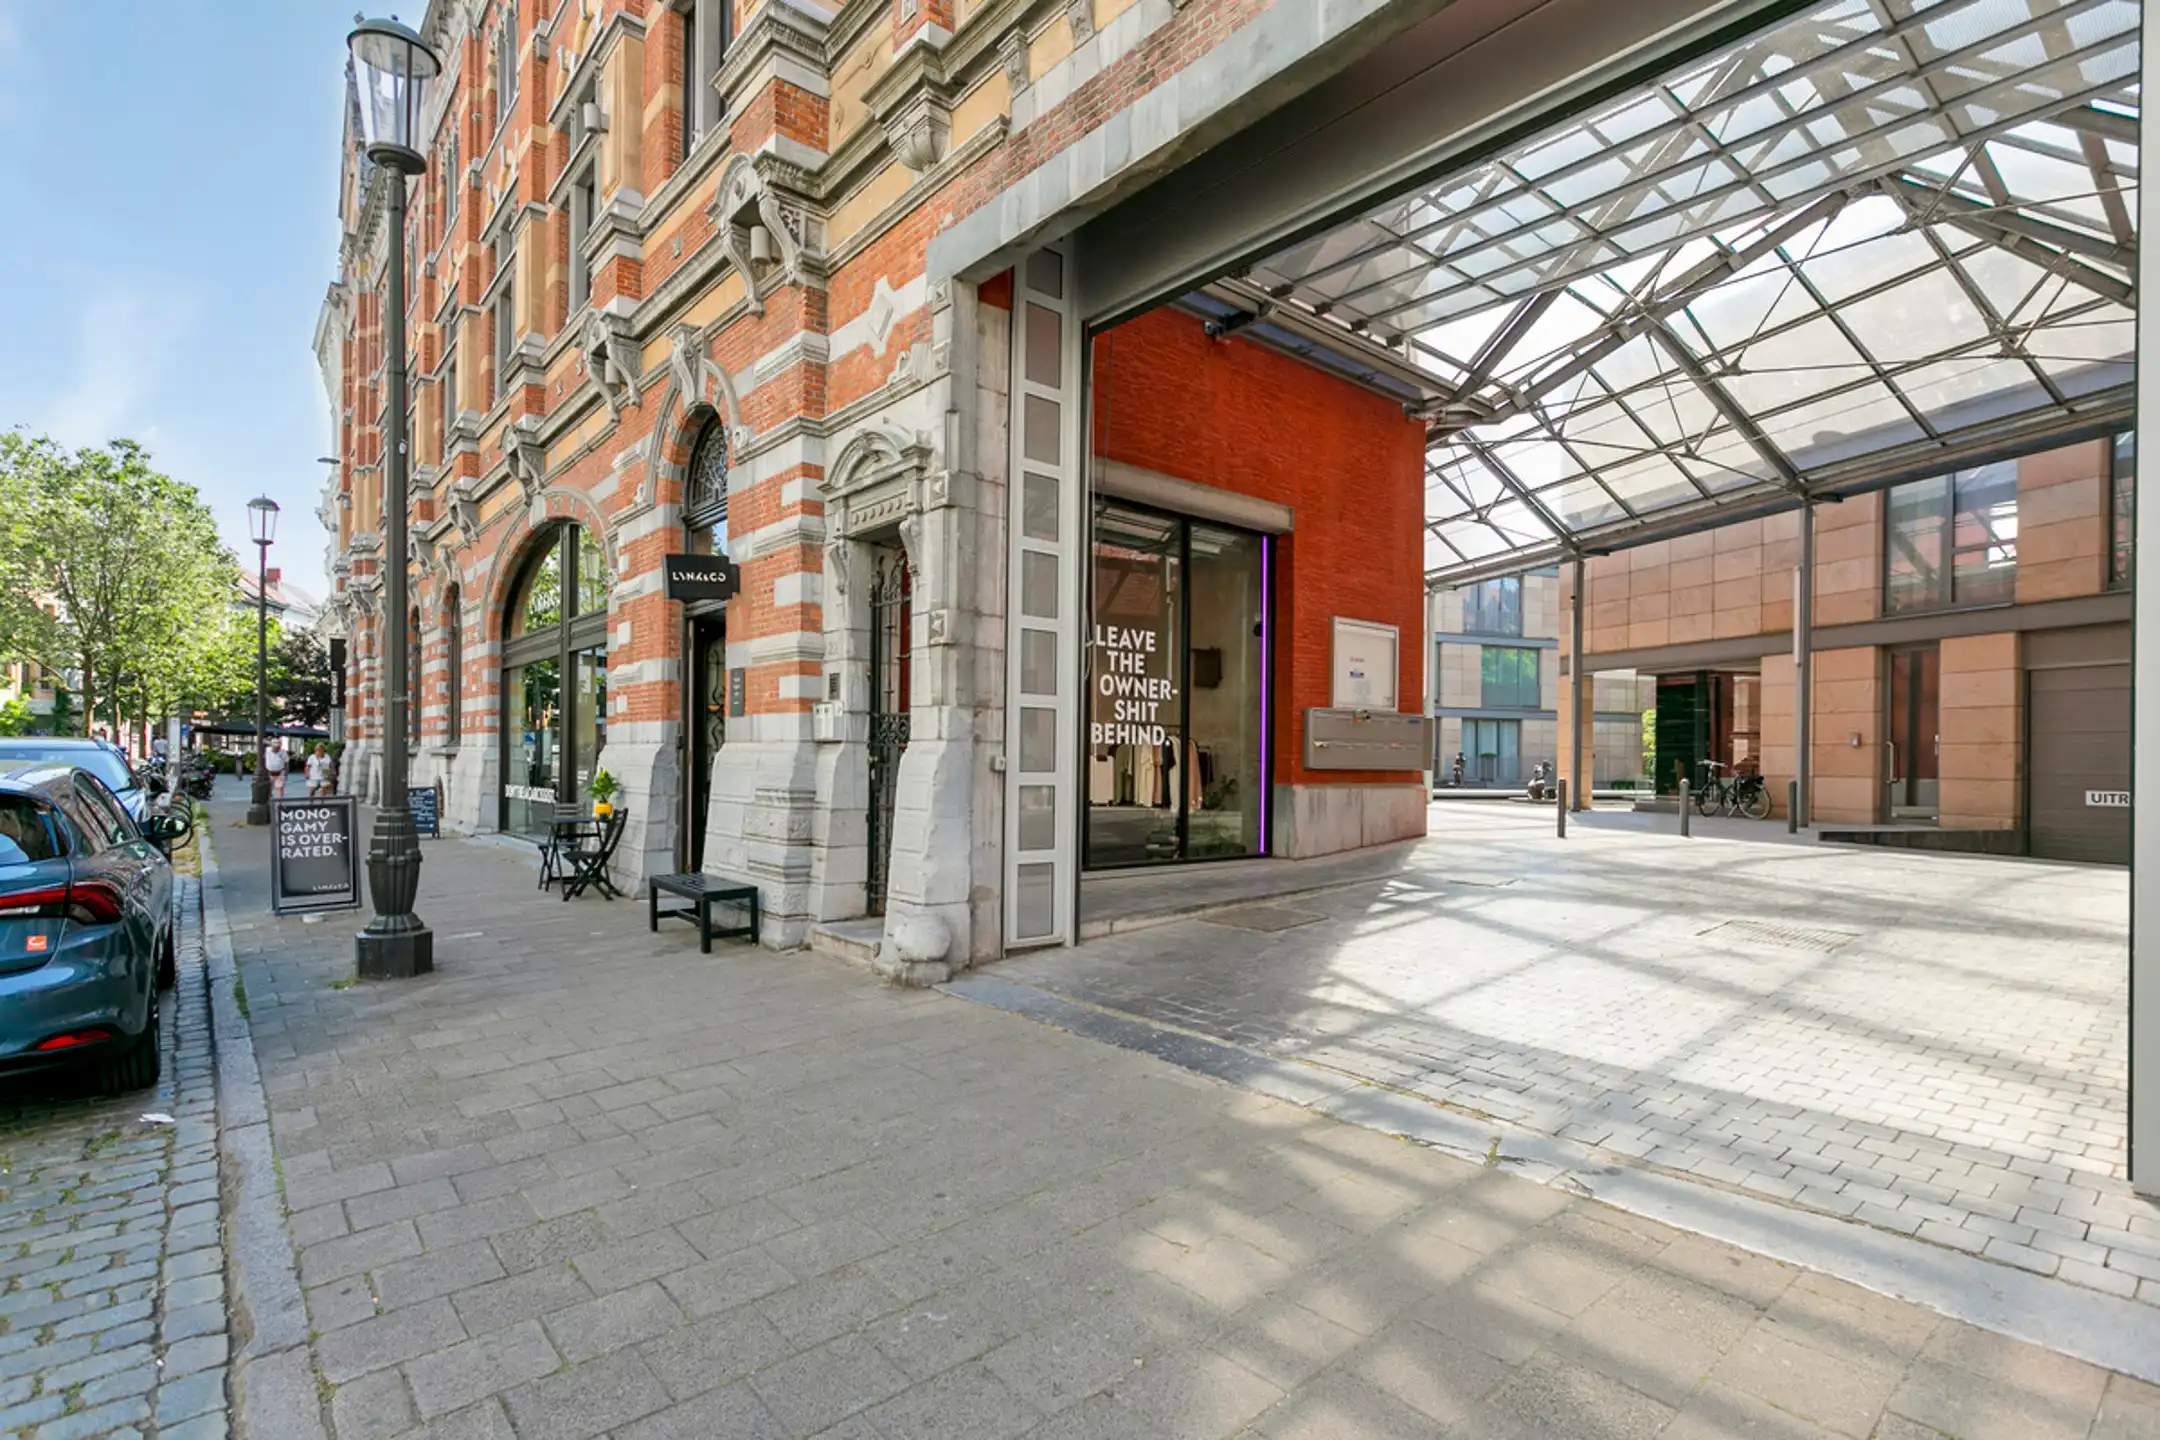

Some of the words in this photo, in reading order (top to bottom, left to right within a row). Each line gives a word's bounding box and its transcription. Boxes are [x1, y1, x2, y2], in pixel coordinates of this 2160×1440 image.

[1096, 624, 1156, 652] LEAVE
[1107, 650, 1145, 674] THE
[1100, 674, 1178, 700] OWNER-
[1114, 699, 1159, 722] SHIT
[1090, 722, 1170, 746] BEHIND.
[281, 808, 337, 821] MONO-
[280, 821, 328, 834] GAMY
[281, 835, 296, 846] IS
[299, 833, 348, 845] OVER-
[281, 846, 338, 859] RATED.
